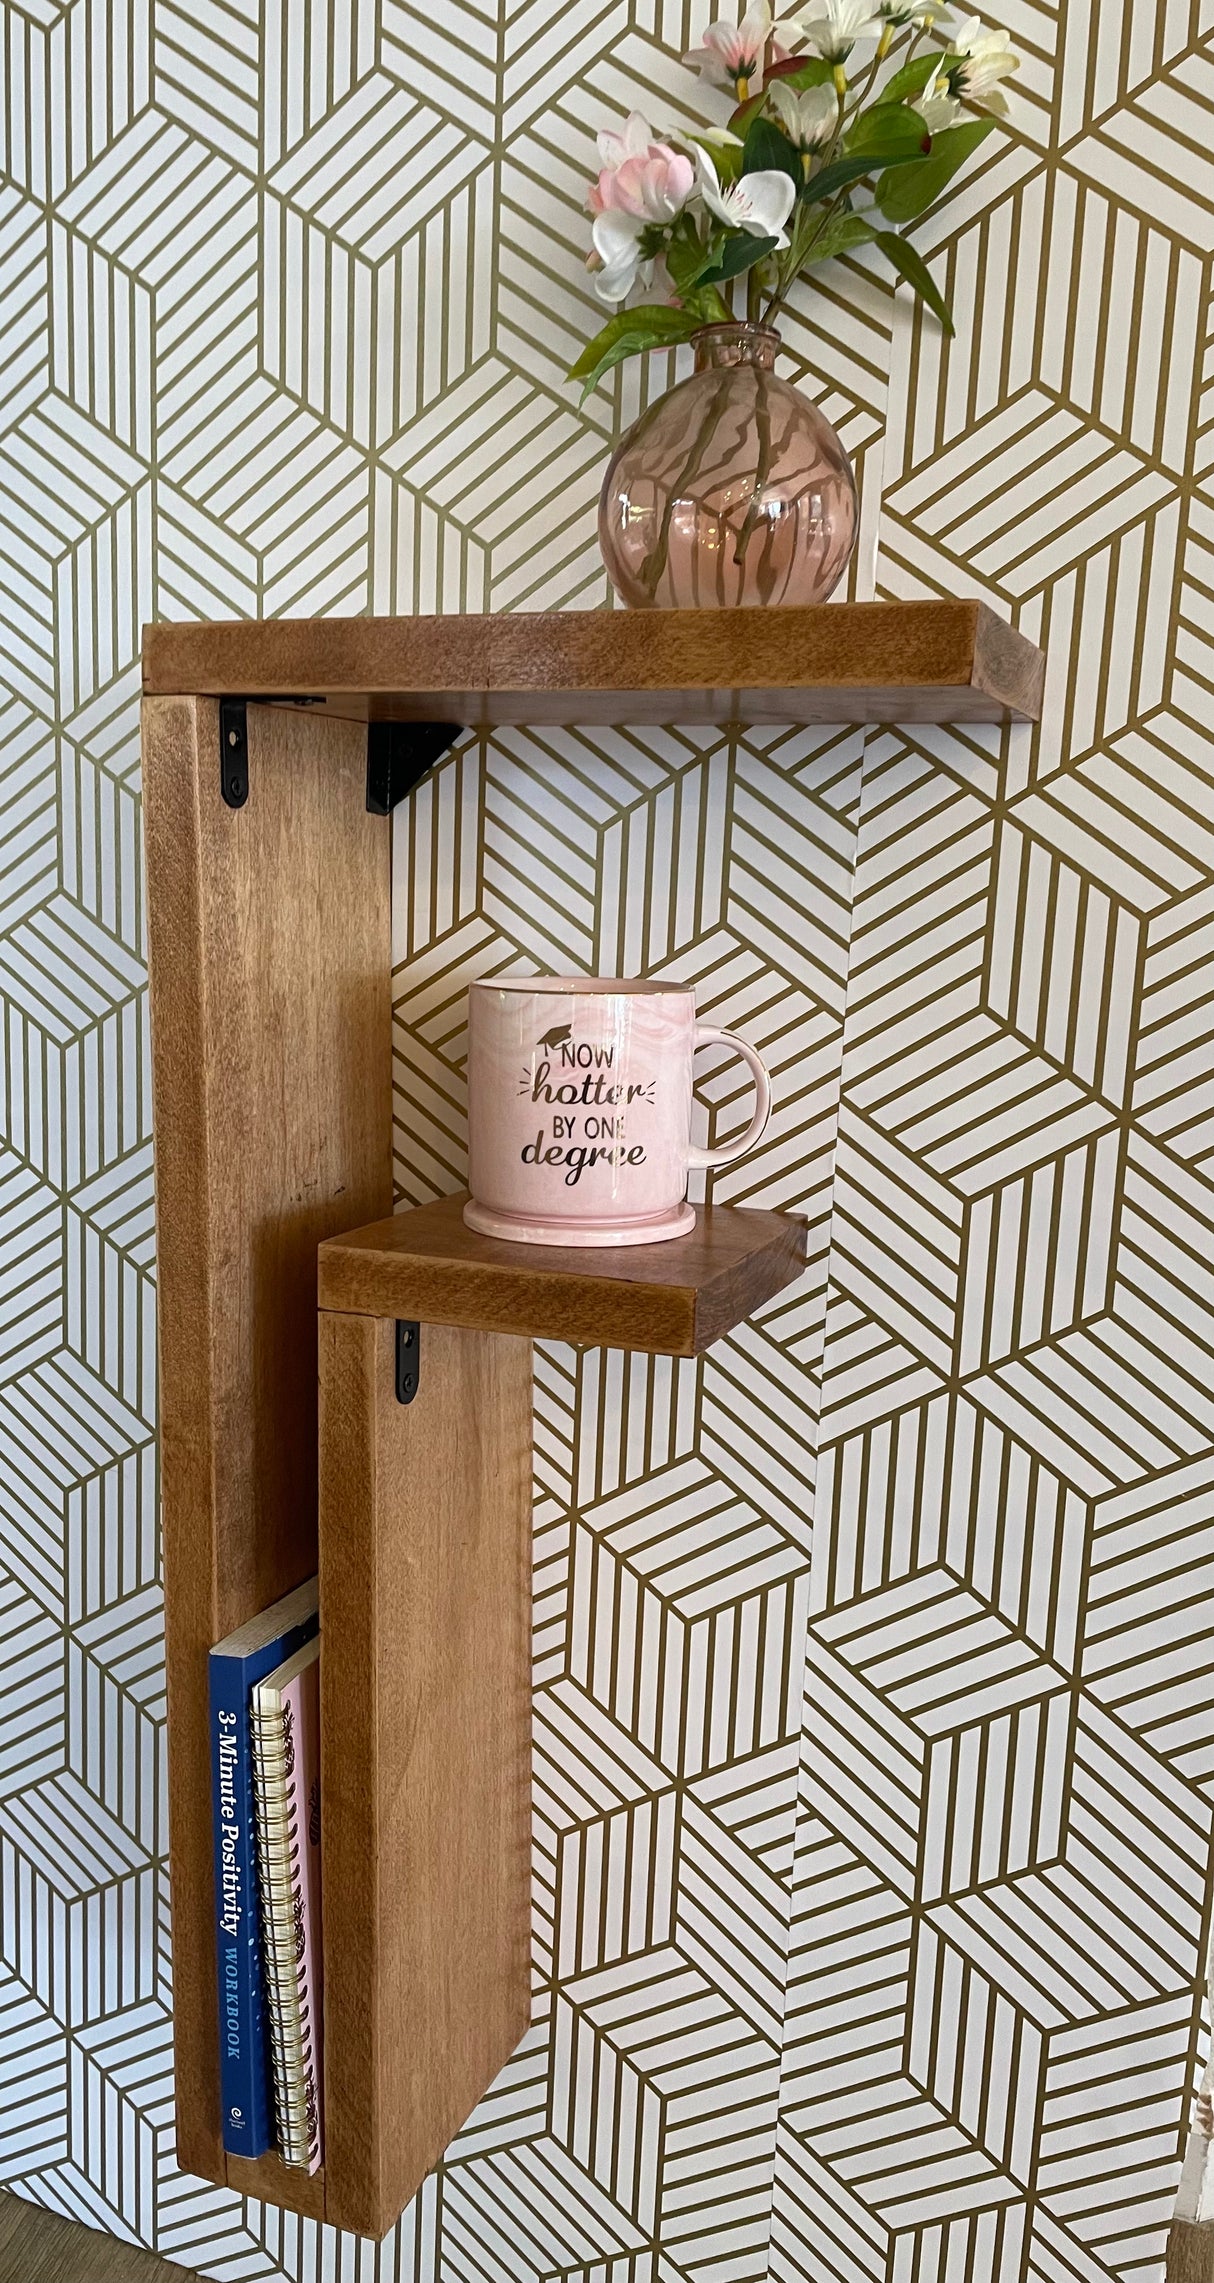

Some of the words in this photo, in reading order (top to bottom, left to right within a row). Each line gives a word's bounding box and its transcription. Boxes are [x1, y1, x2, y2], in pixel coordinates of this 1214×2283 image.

[531, 1062, 647, 1105] hotter
[561, 1043, 614, 1068] NOW
[552, 1116, 576, 1139] BY
[584, 1116, 626, 1139] ONE
[521, 1130, 647, 1186] degree
[218, 1710, 239, 1819] 3-Minute
[219, 1823, 242, 1937] Positivity
[225, 1947, 240, 2060] WORKBOOK
